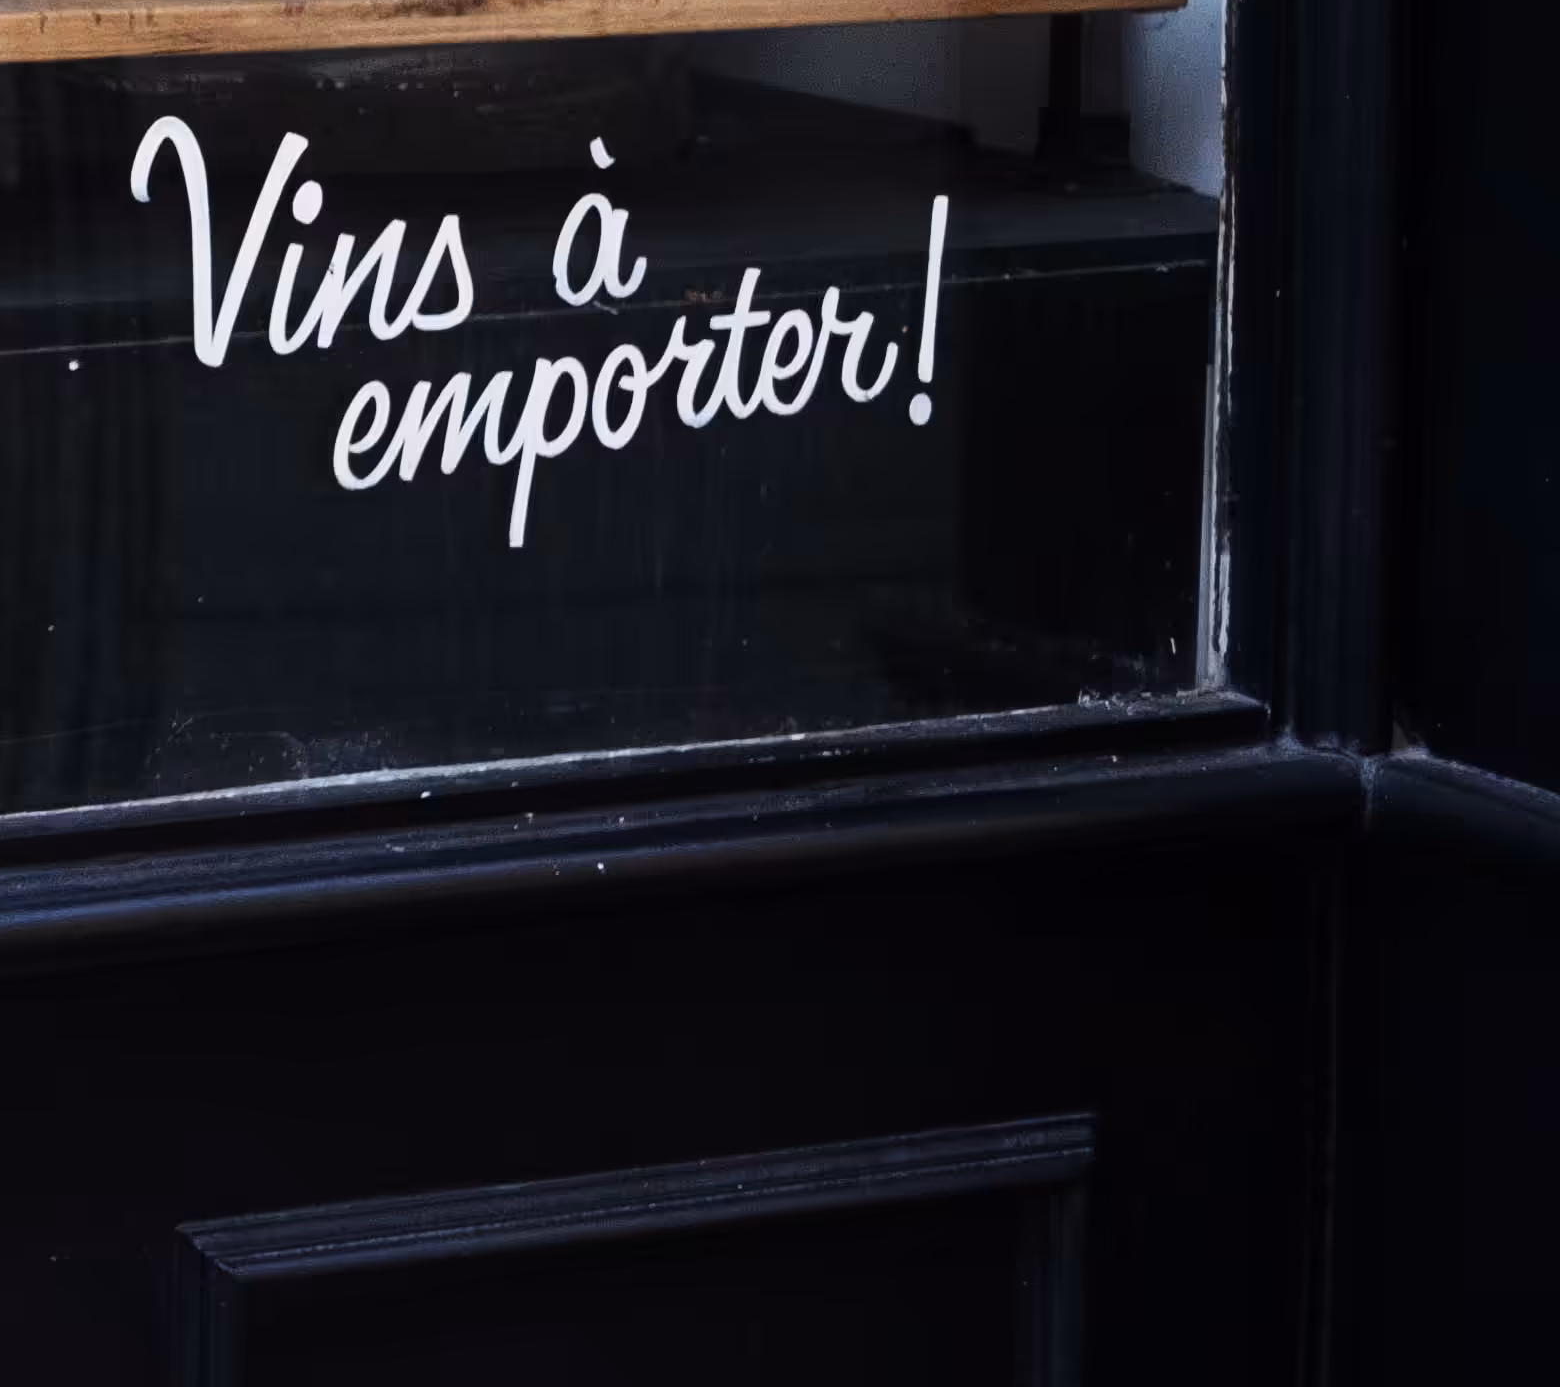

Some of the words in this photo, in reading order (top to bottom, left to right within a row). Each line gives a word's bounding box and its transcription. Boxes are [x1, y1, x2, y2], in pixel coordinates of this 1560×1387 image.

[129, 115, 475, 367] Vins
[553, 136, 648, 307] à
[333, 195, 951, 547] emporter!
